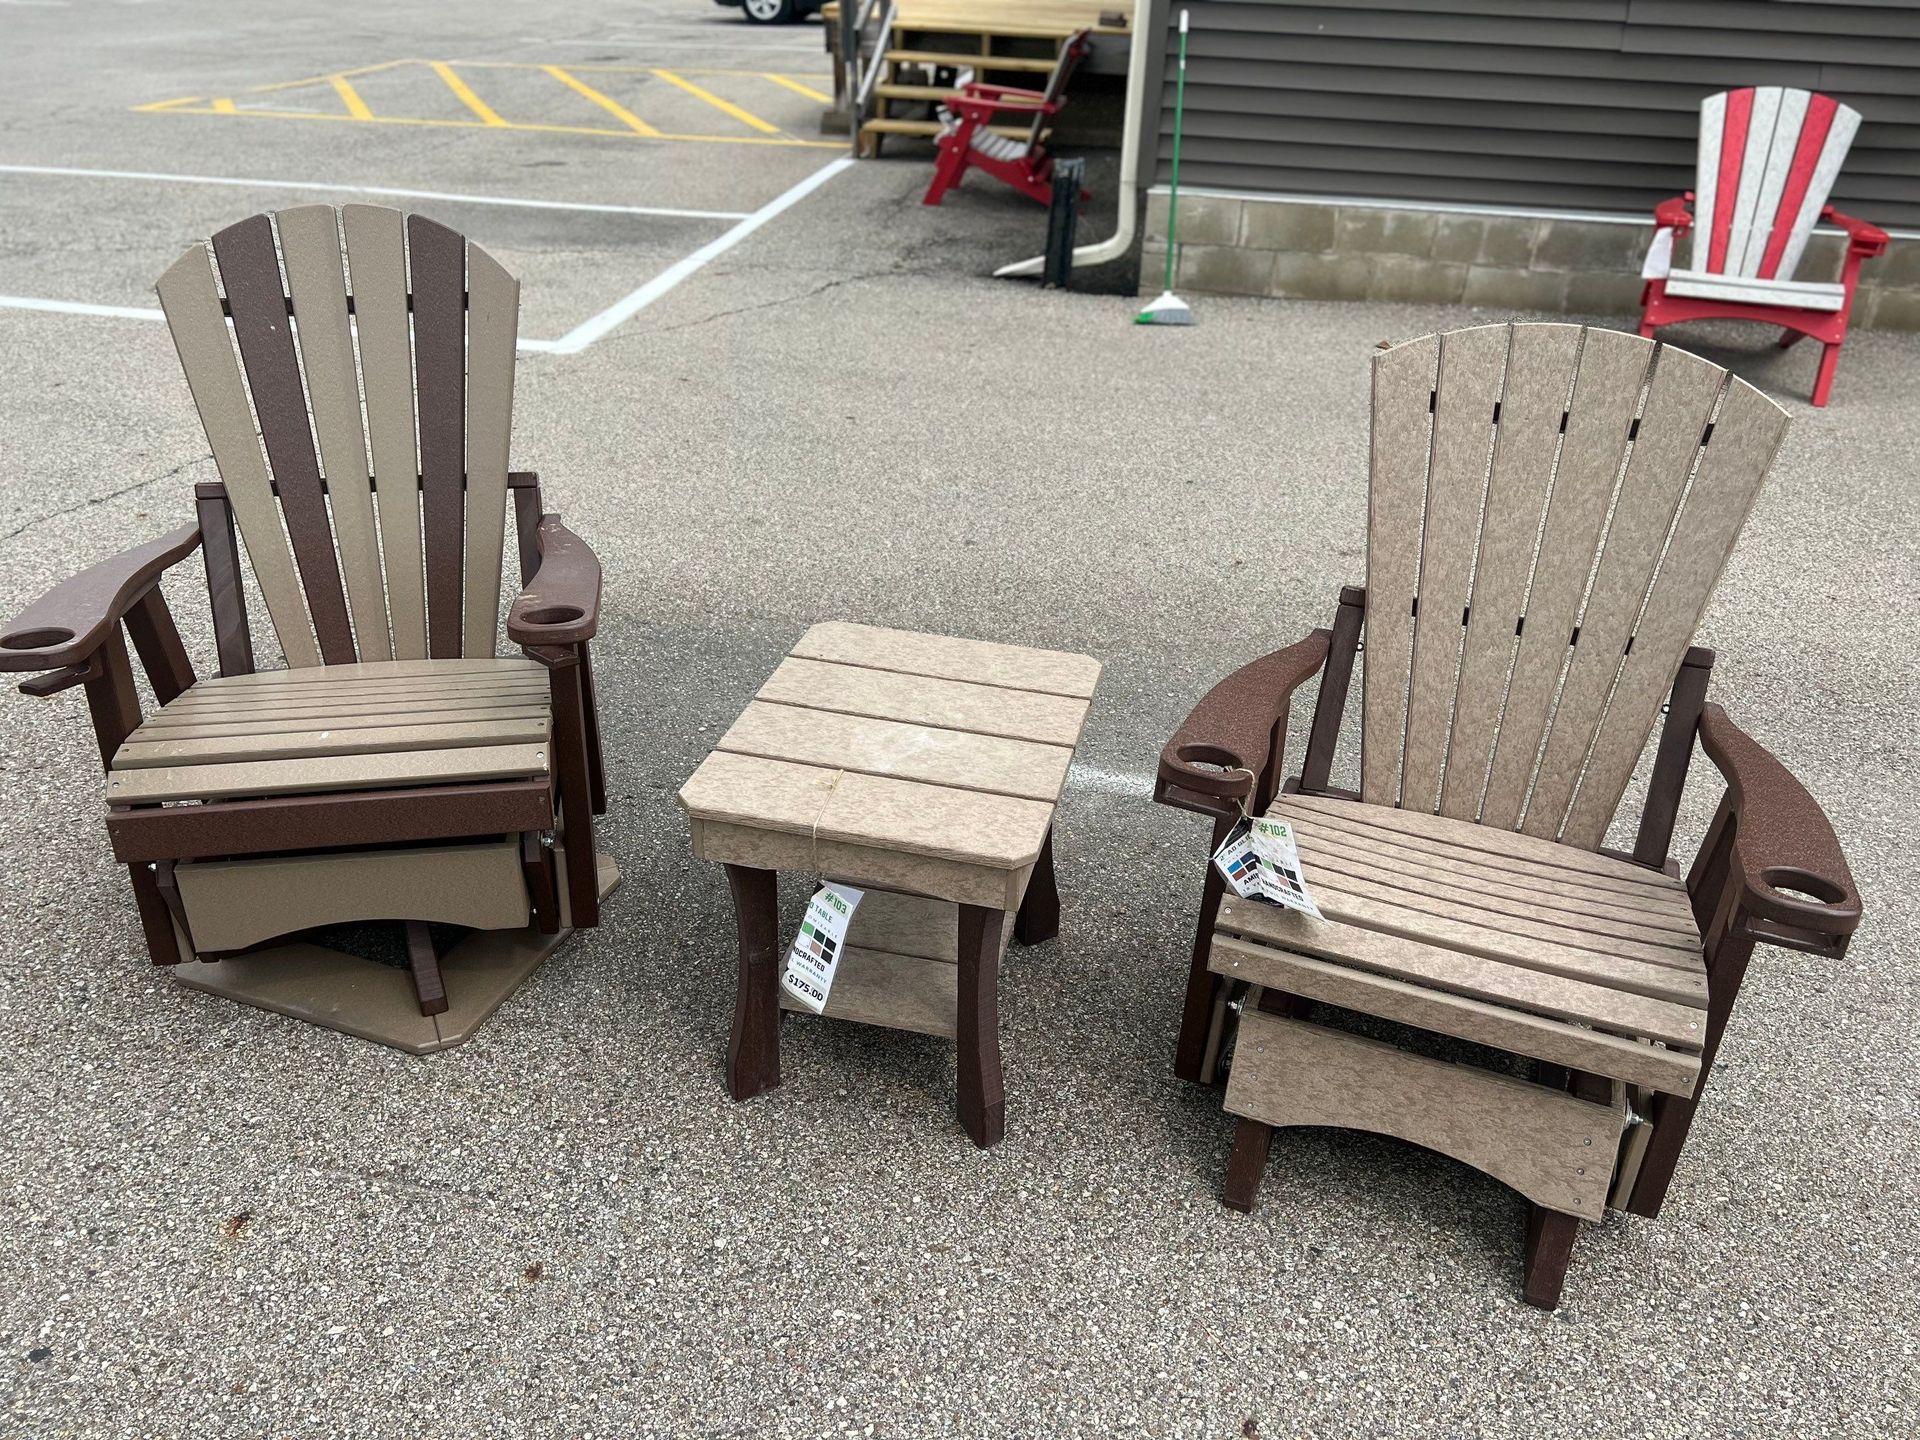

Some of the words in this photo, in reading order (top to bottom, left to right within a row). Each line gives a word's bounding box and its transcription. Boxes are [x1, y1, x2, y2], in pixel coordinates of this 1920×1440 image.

[1259, 822, 1287, 837] #102
[815, 903, 833, 923] TABLE
[825, 892, 847, 914] #103
[796, 960, 827, 984] WARRANTY
[788, 974, 824, 1001] $175.00
